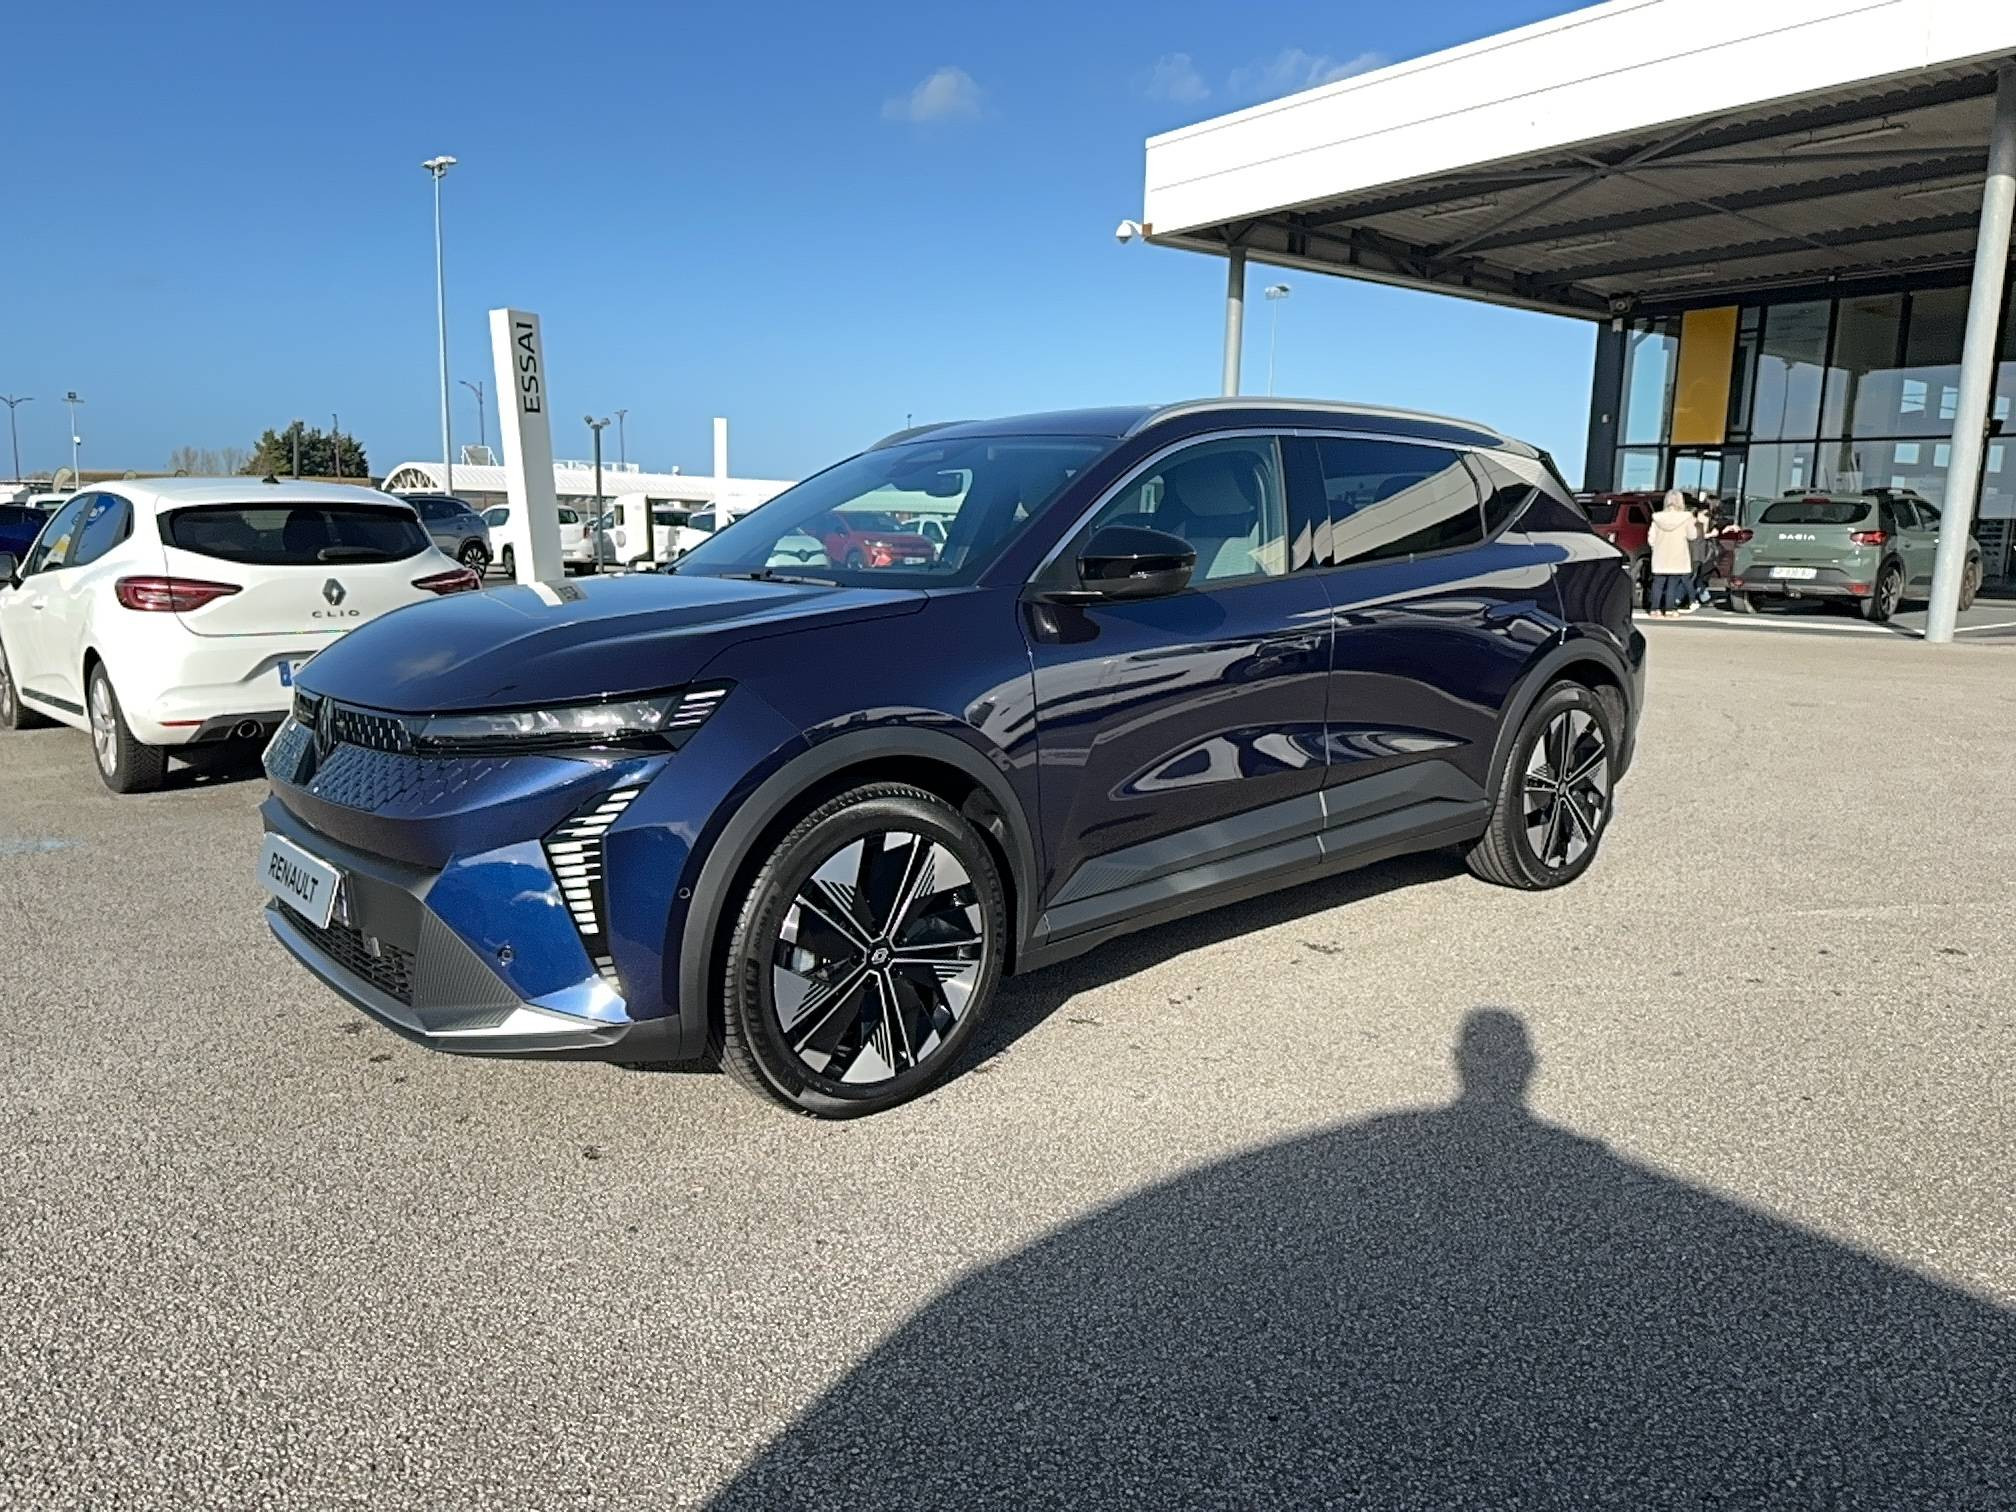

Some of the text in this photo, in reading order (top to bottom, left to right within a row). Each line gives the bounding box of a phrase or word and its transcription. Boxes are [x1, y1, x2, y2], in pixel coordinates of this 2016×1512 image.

[516, 322, 541, 413] ESSAI
[1778, 533, 1816, 541] DACIA
[311, 609, 361, 618] CLIO
[267, 851, 320, 904] RENAULT
